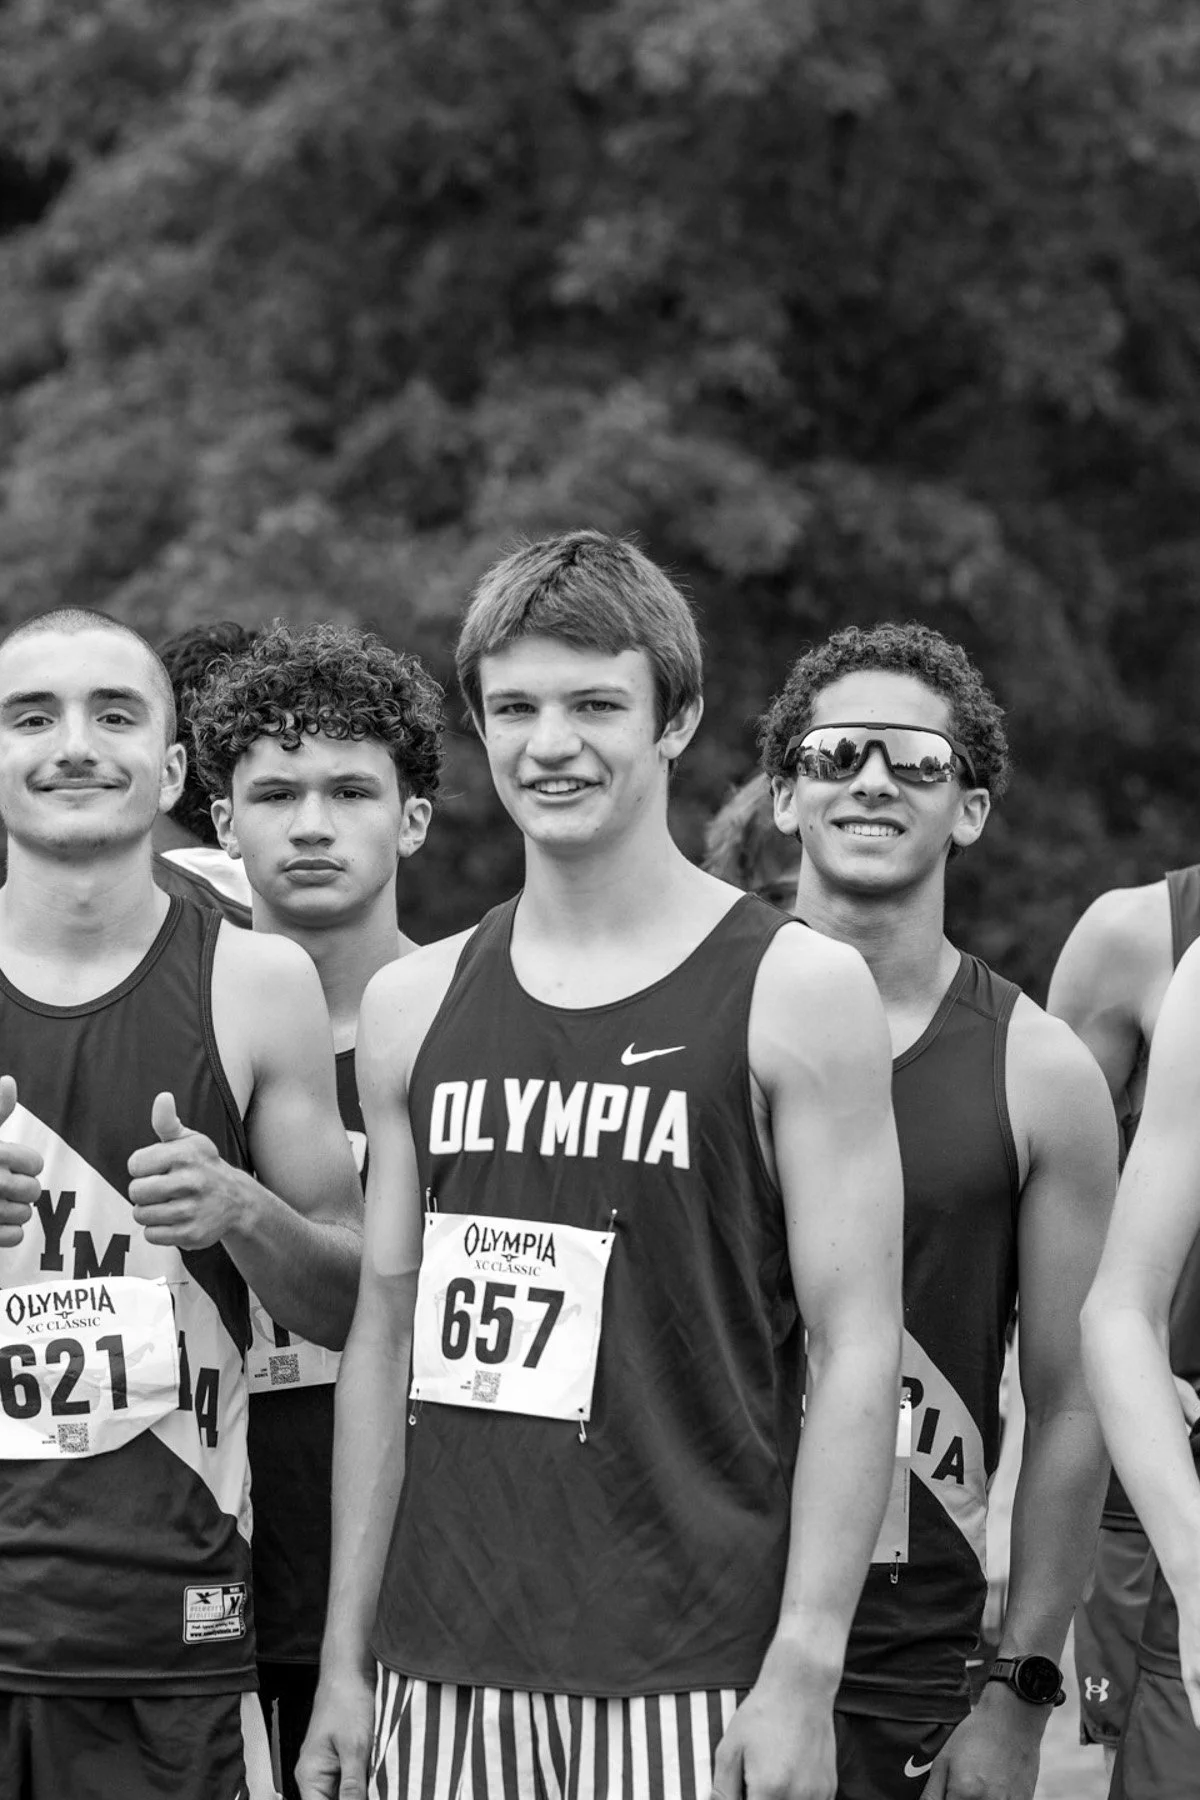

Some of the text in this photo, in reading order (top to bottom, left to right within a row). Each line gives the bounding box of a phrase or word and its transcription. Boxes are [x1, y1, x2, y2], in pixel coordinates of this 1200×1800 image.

[429, 1078, 690, 1170] OLYMPIA
[464, 1222, 556, 1268] OLYMPIA
[474, 1259, 542, 1277] XC CLASSIC
[5, 1284, 116, 1326] OLYMPIA
[26, 1316, 101, 1335] XC CLASSIC
[441, 1277, 565, 1369] 657
